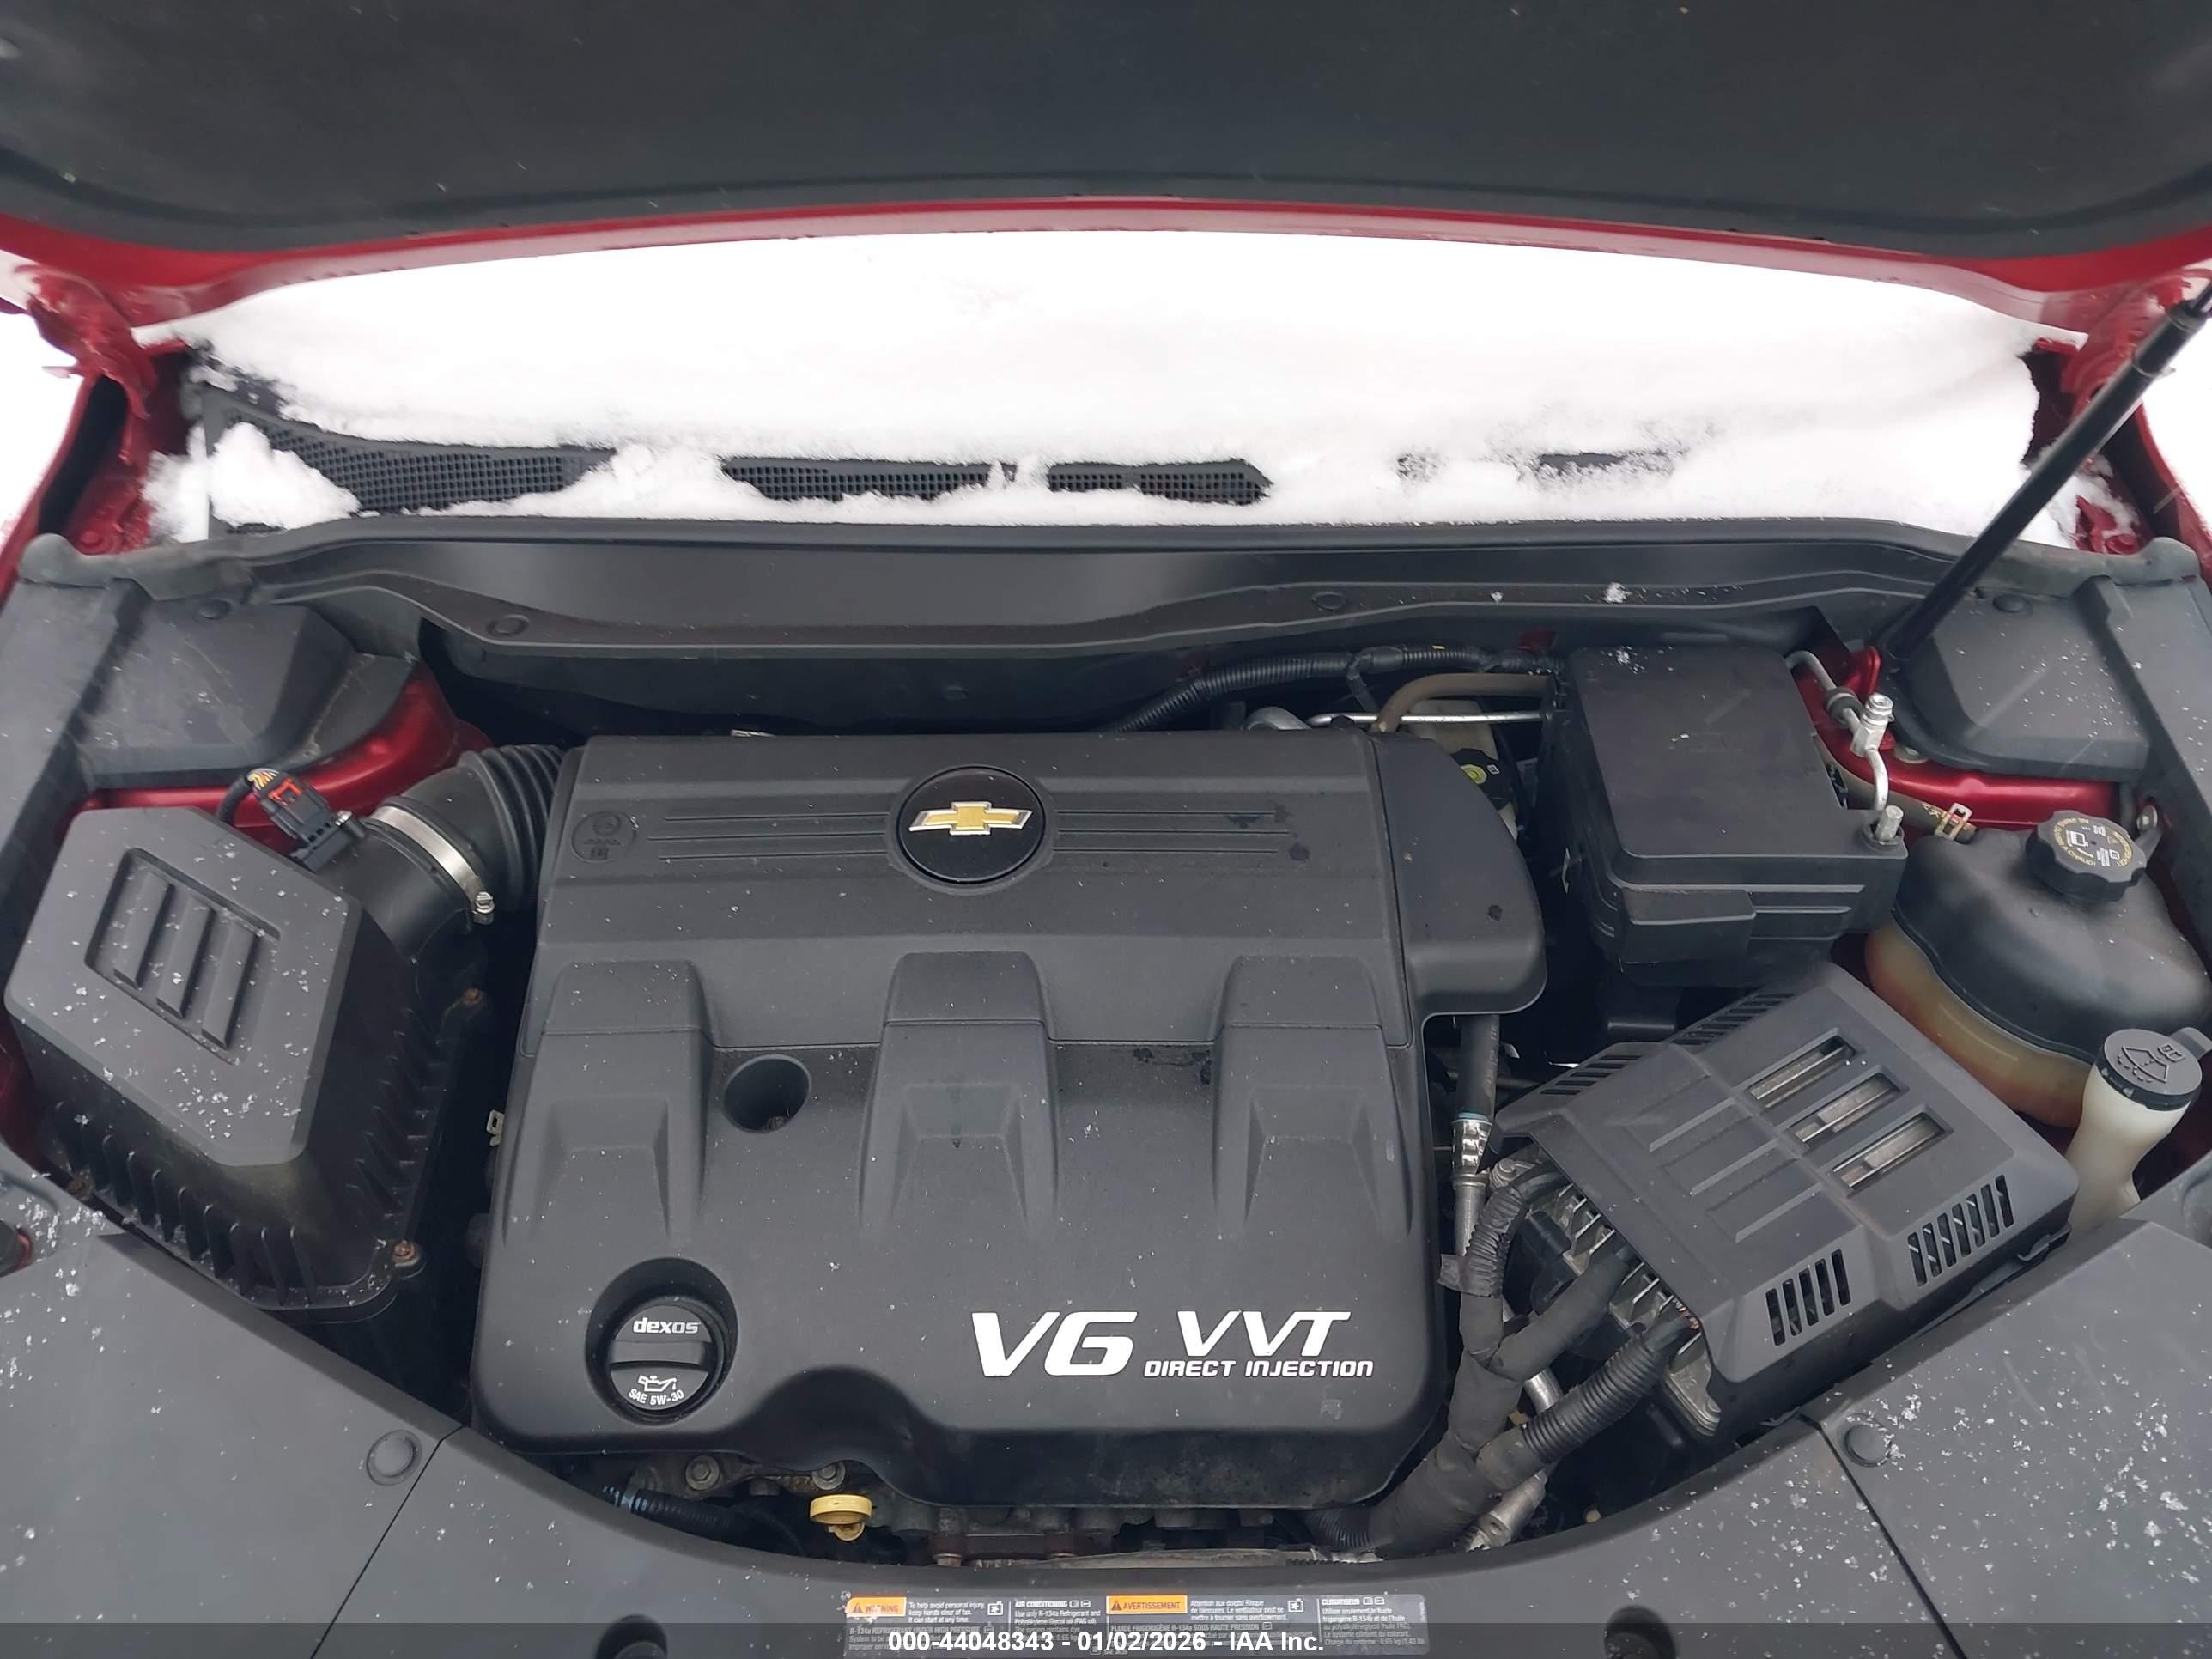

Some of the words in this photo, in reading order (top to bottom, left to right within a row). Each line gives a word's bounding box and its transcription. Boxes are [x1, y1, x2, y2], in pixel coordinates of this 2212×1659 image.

[633, 1316, 701, 1334] dexos
[971, 1310, 1139, 1377] V6
[1176, 1310, 1352, 1357] VVT
[1143, 1360, 1237, 1377] DIRECT
[1244, 1360, 1374, 1377] INJECTION
[629, 1388, 648, 1404] SAE
[649, 1389, 685, 1406] 5W-30
[1123, 1601, 1182, 1610] AVERTISSEMENT
